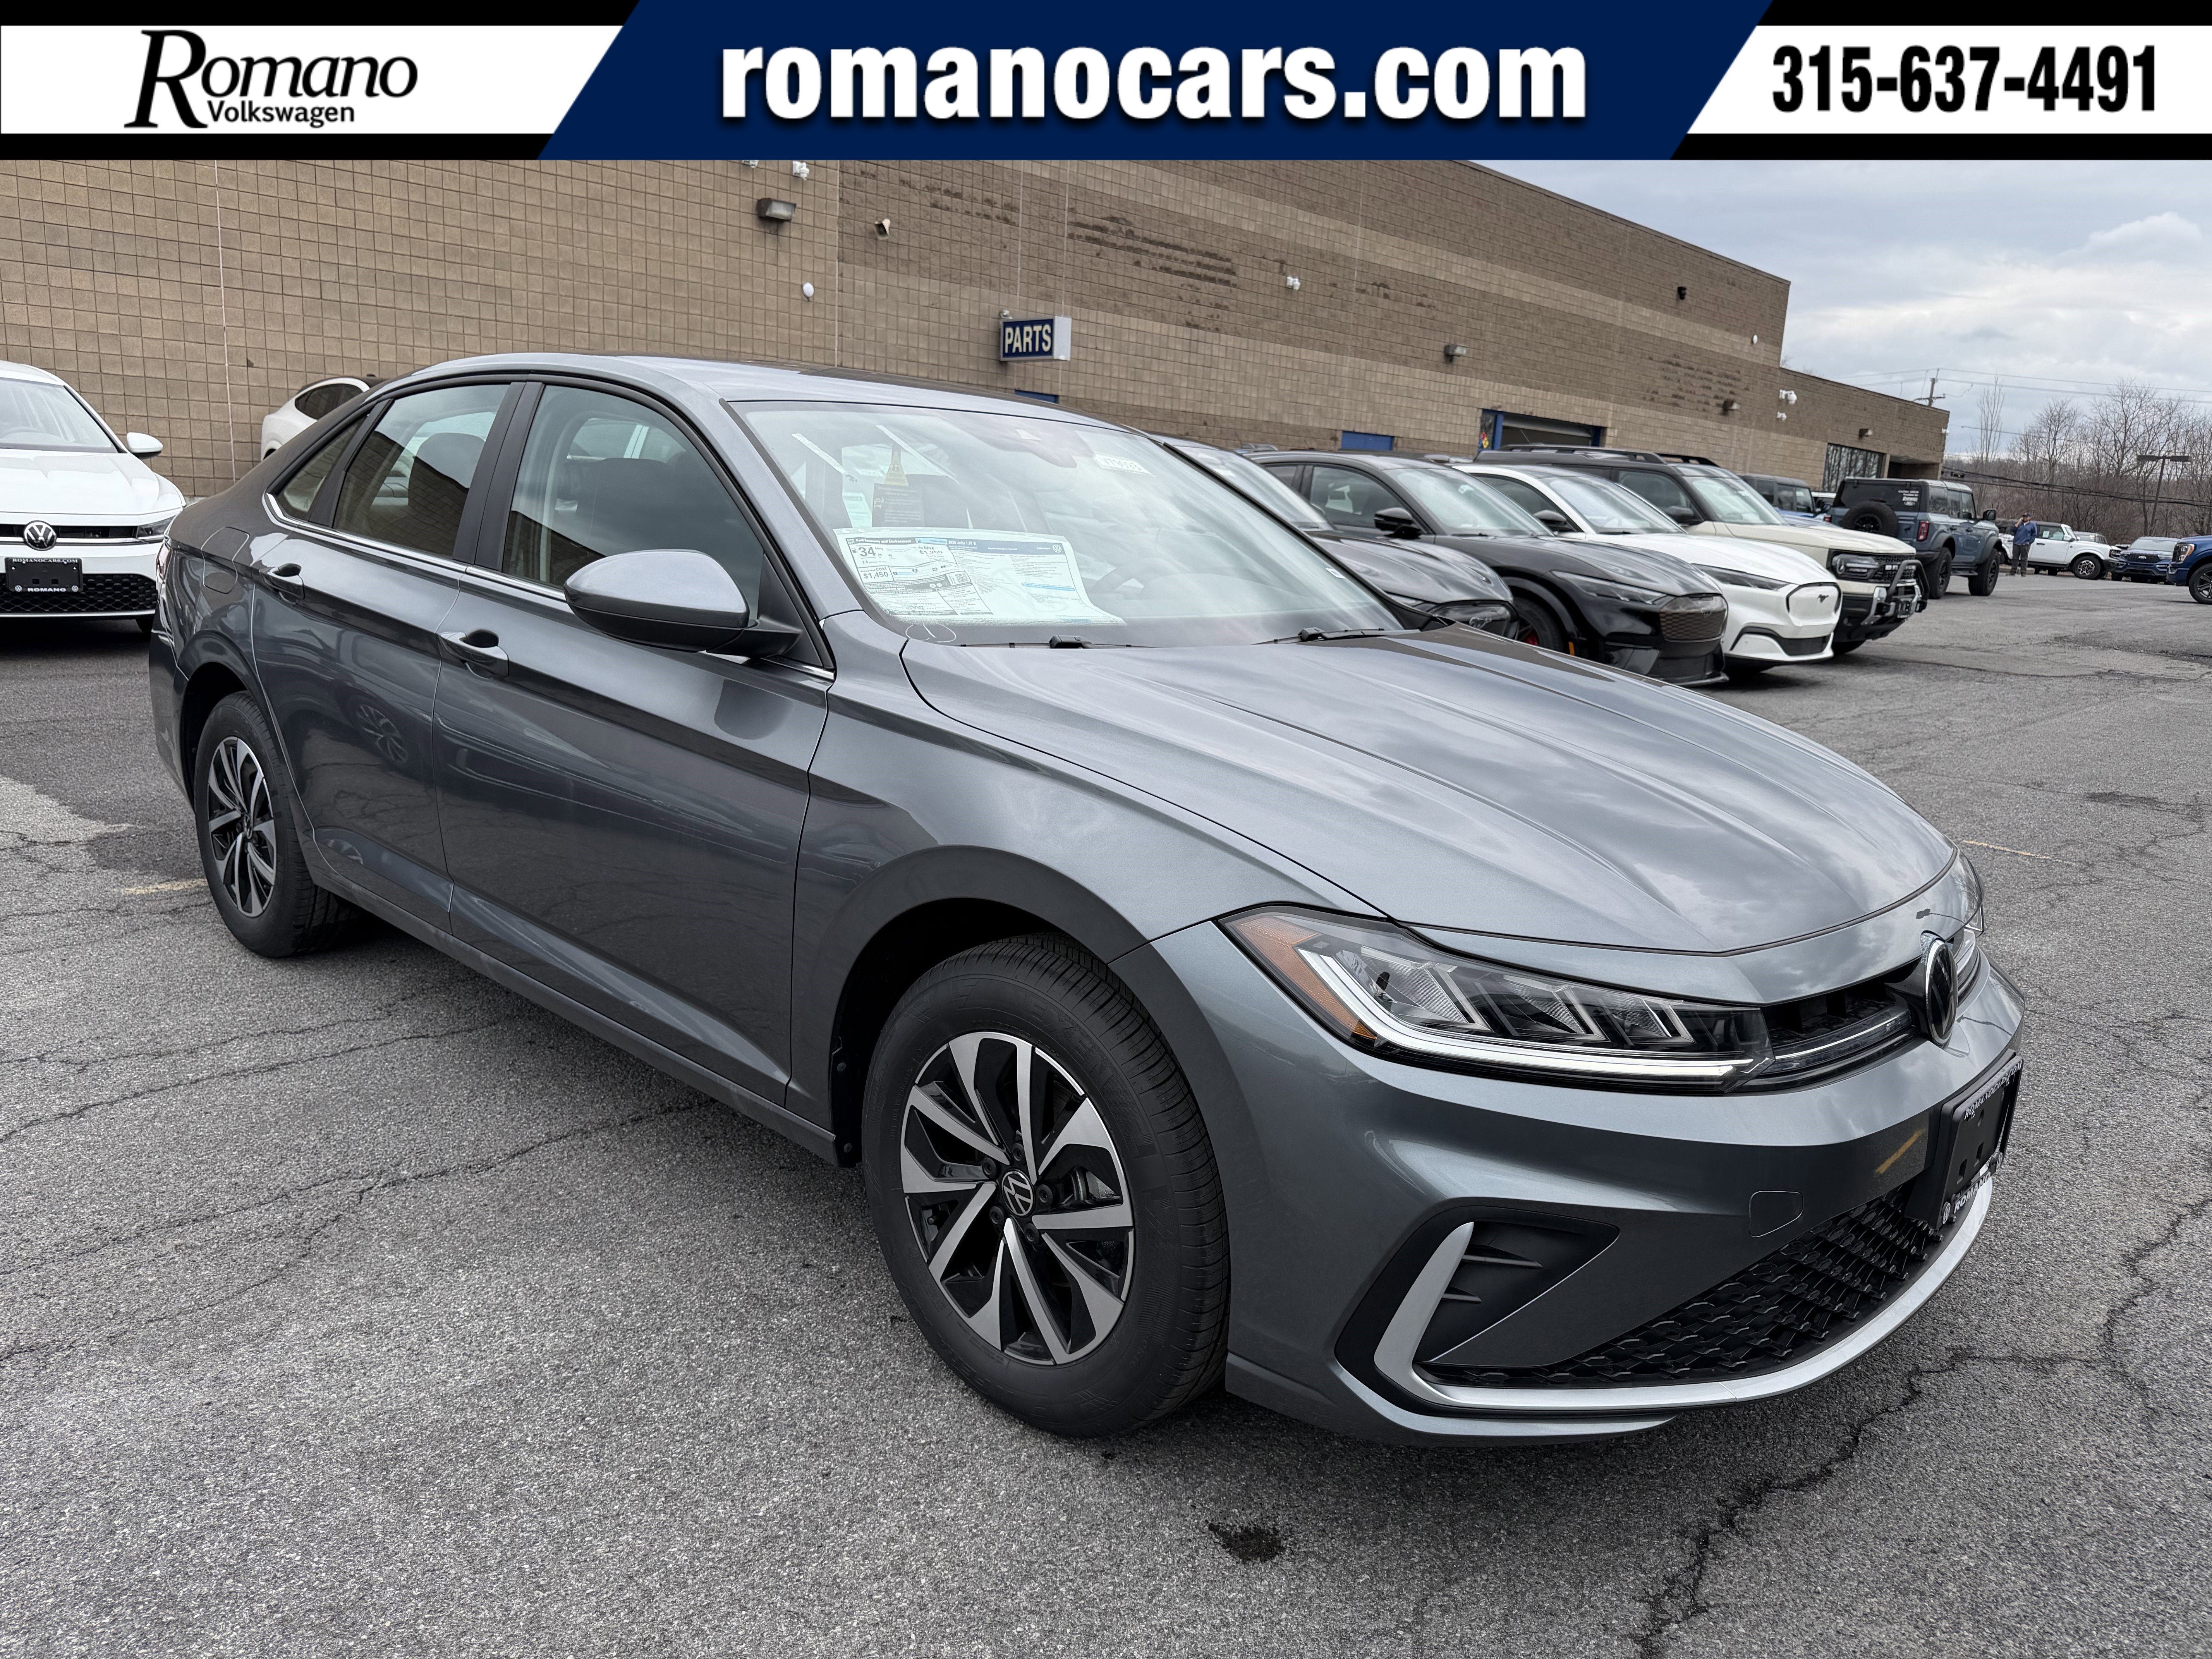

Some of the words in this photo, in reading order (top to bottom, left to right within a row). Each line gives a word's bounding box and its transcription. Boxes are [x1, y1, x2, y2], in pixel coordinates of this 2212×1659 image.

[1005, 324, 1051, 353] PARTS
[858, 547, 876, 557] 34
[1954, 1172, 1990, 1214] ROMANO
